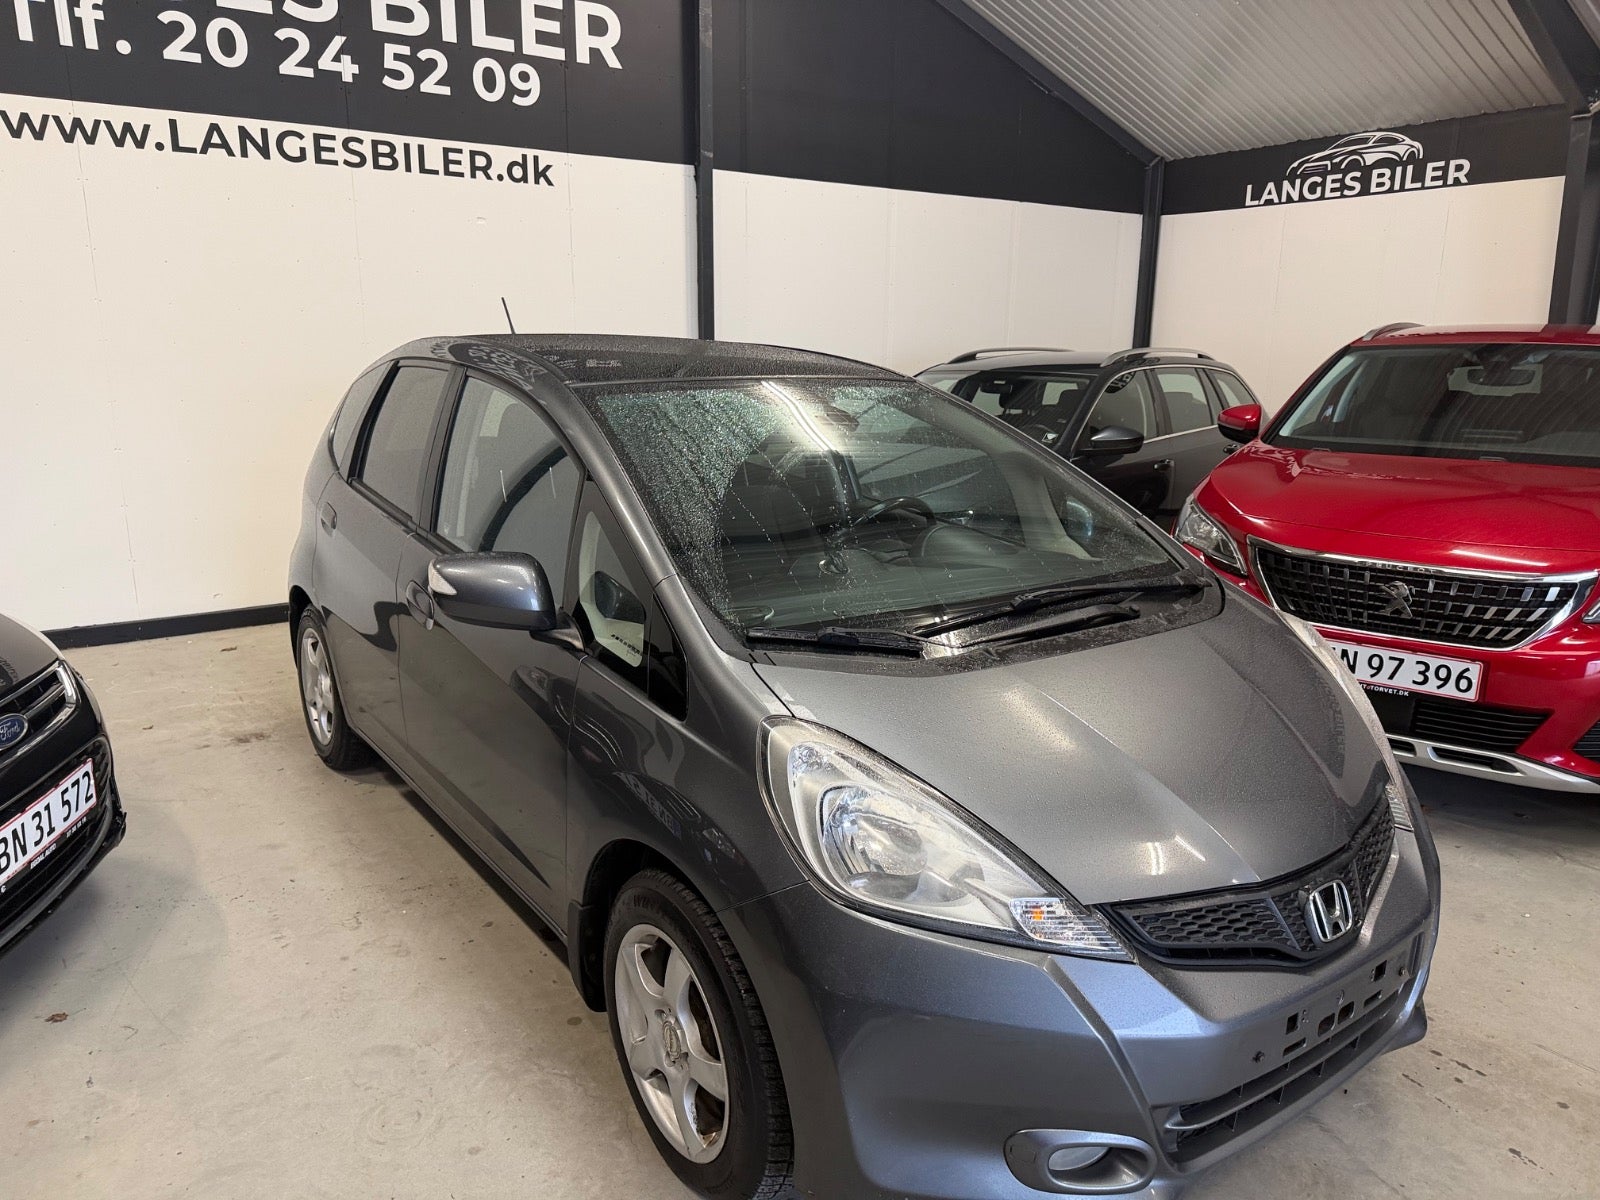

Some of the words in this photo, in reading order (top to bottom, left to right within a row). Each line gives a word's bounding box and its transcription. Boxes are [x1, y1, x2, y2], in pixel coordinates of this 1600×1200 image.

[0, 0, 132, 55] Tlf.
[156, 10, 249, 68] 20
[273, 27, 360, 83] 24
[381, 42, 451, 96] 52
[472, 57, 541, 107] 09
[371, 0, 623, 69] BILER
[0, 109, 555, 187] www.LANGESBILER.dk
[1244, 170, 1362, 207] LANGES
[1369, 157, 1472, 194] BILER
[1331, 646, 1359, 675] N
[1367, 653, 1405, 680] 97
[1411, 660, 1473, 694] 396
[0, 721, 21, 741] Ford
[0, 821, 28, 875] BN
[31, 801, 56, 848] 31
[60, 770, 94, 823] 572
